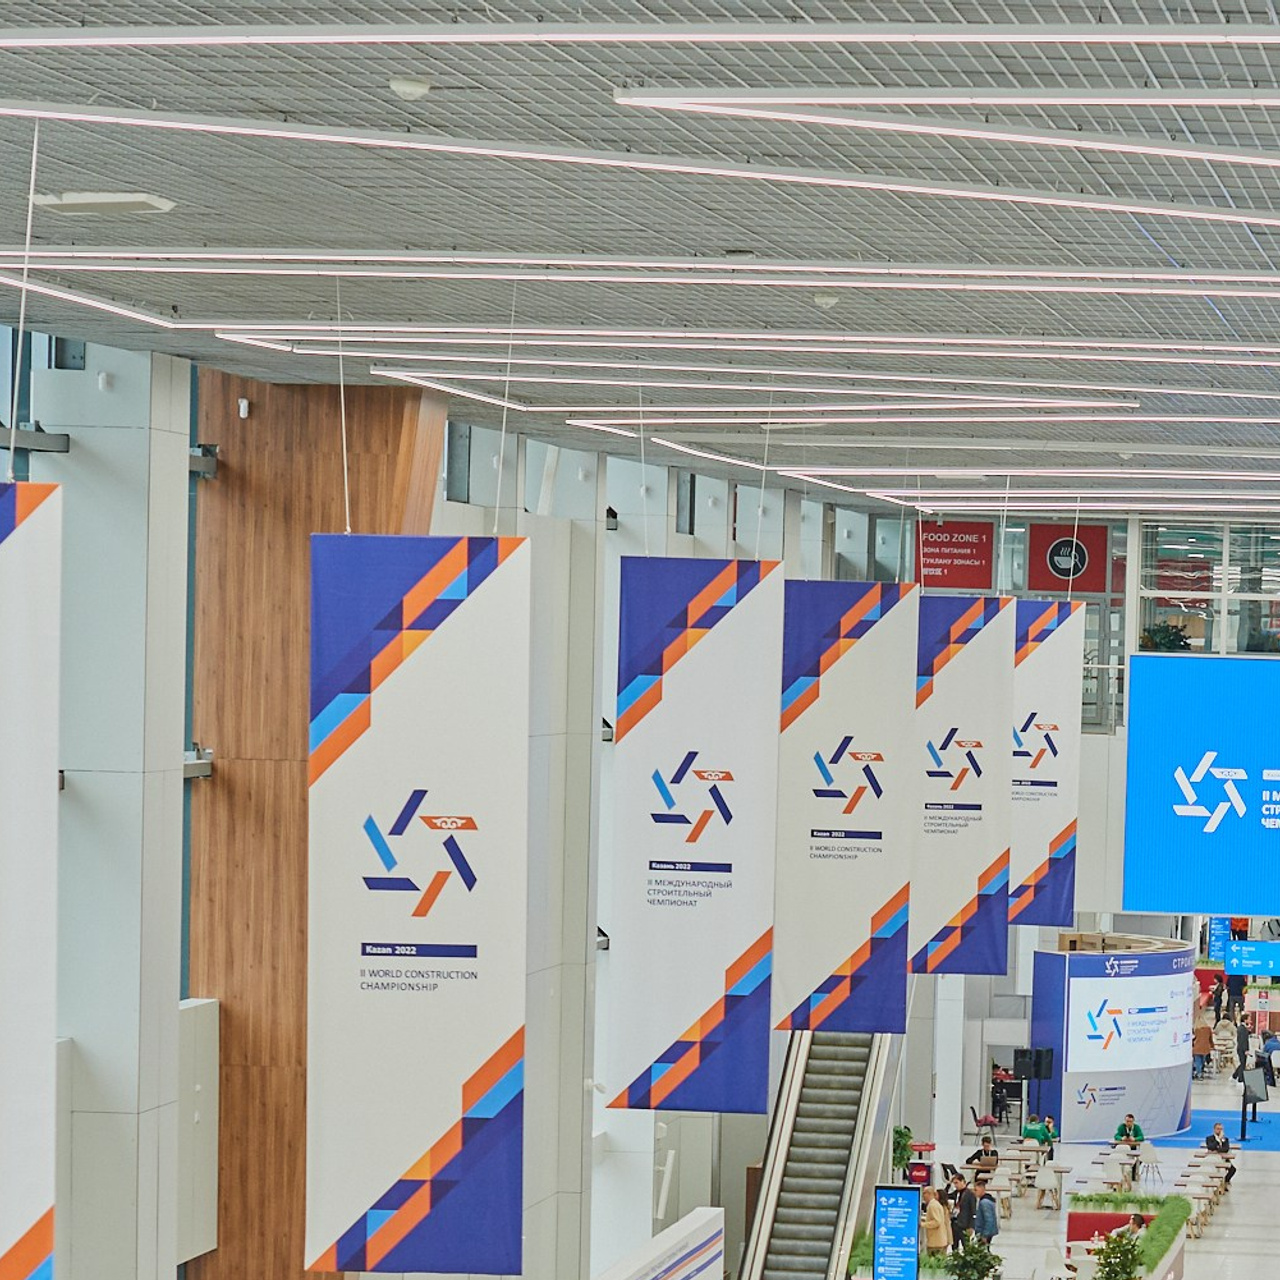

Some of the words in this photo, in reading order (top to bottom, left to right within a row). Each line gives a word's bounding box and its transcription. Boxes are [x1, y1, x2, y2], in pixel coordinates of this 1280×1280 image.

[923, 533, 950, 542] FOOD
[952, 534, 979, 542] ZONE
[982, 535, 986, 543] 1
[1262, 791, 1270, 801] II
[655, 879, 732, 889] МЕЖДУНАРОДНЫЙ
[647, 888, 712, 898] СТРОИТЕЛЬНЫЙ
[647, 899, 698, 907] ЧЕМПИОНАТ
[365, 945, 393, 954] Kazan
[394, 946, 417, 955] 2022
[360, 969, 366, 977] II
[368, 969, 403, 978] WORLD
[404, 970, 478, 980] CONSTRUCTION
[360, 982, 439, 991] CHAMPIONSHIP
